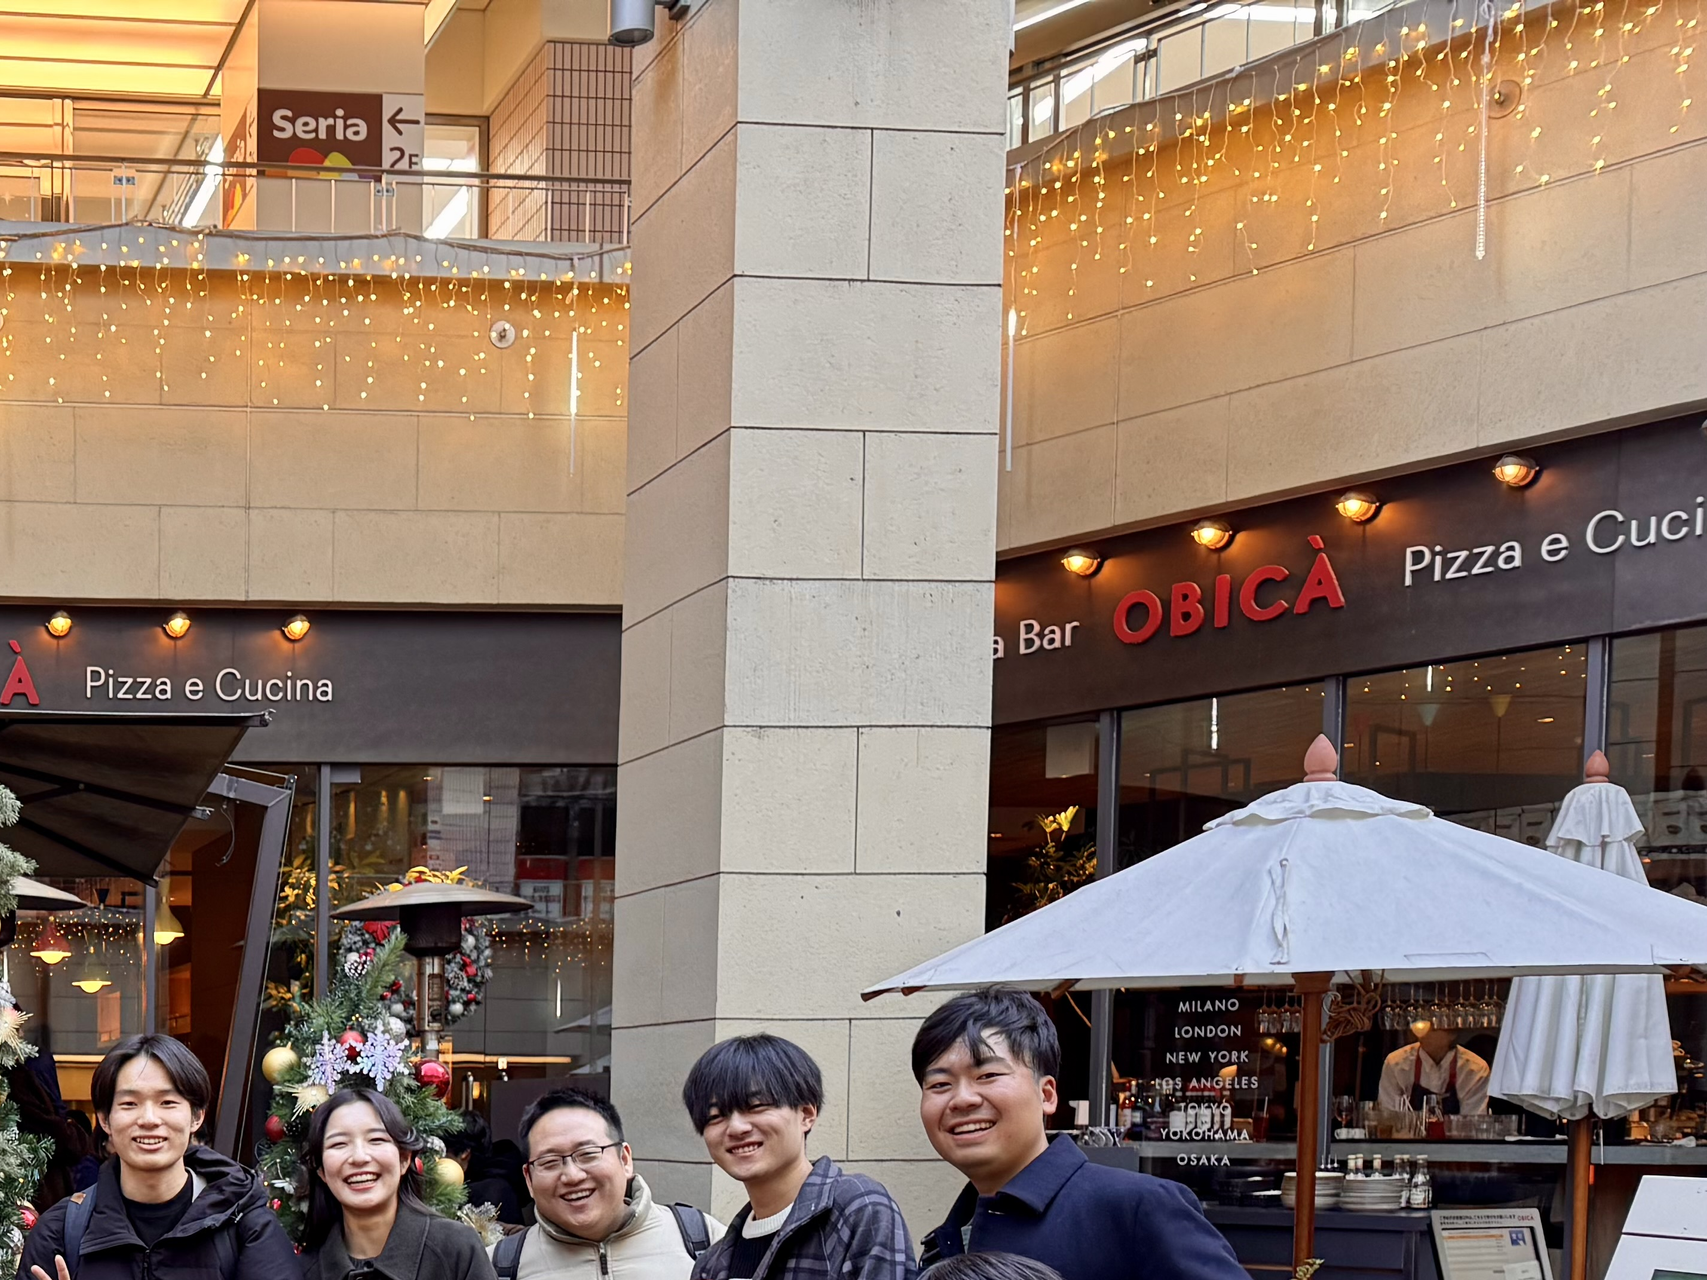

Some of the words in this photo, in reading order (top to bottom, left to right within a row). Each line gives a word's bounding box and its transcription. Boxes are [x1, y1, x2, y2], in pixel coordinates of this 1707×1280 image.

[272, 108, 368, 141] Seria
[1019, 618, 1080, 655] Bar
[1113, 535, 1345, 644] OBICÀ
[1404, 540, 1522, 586] Pizza
[1541, 533, 1569, 562] e
[85, 666, 172, 699] Pizza
[184, 677, 204, 700] e
[215, 668, 333, 701] Cucina
[1178, 999, 1239, 1013] MILANO
[1174, 1025, 1241, 1038] LONDON
[1166, 1052, 1201, 1064] NEW
[1209, 1050, 1249, 1063] YORK
[1155, 1077, 1182, 1089] LOS
[1189, 1076, 1259, 1089] ANGELES
[1180, 1103, 1231, 1115] TOKYO
[1160, 1128, 1250, 1140] YOKOHAMA
[1177, 1153, 1231, 1167] OSAKA
